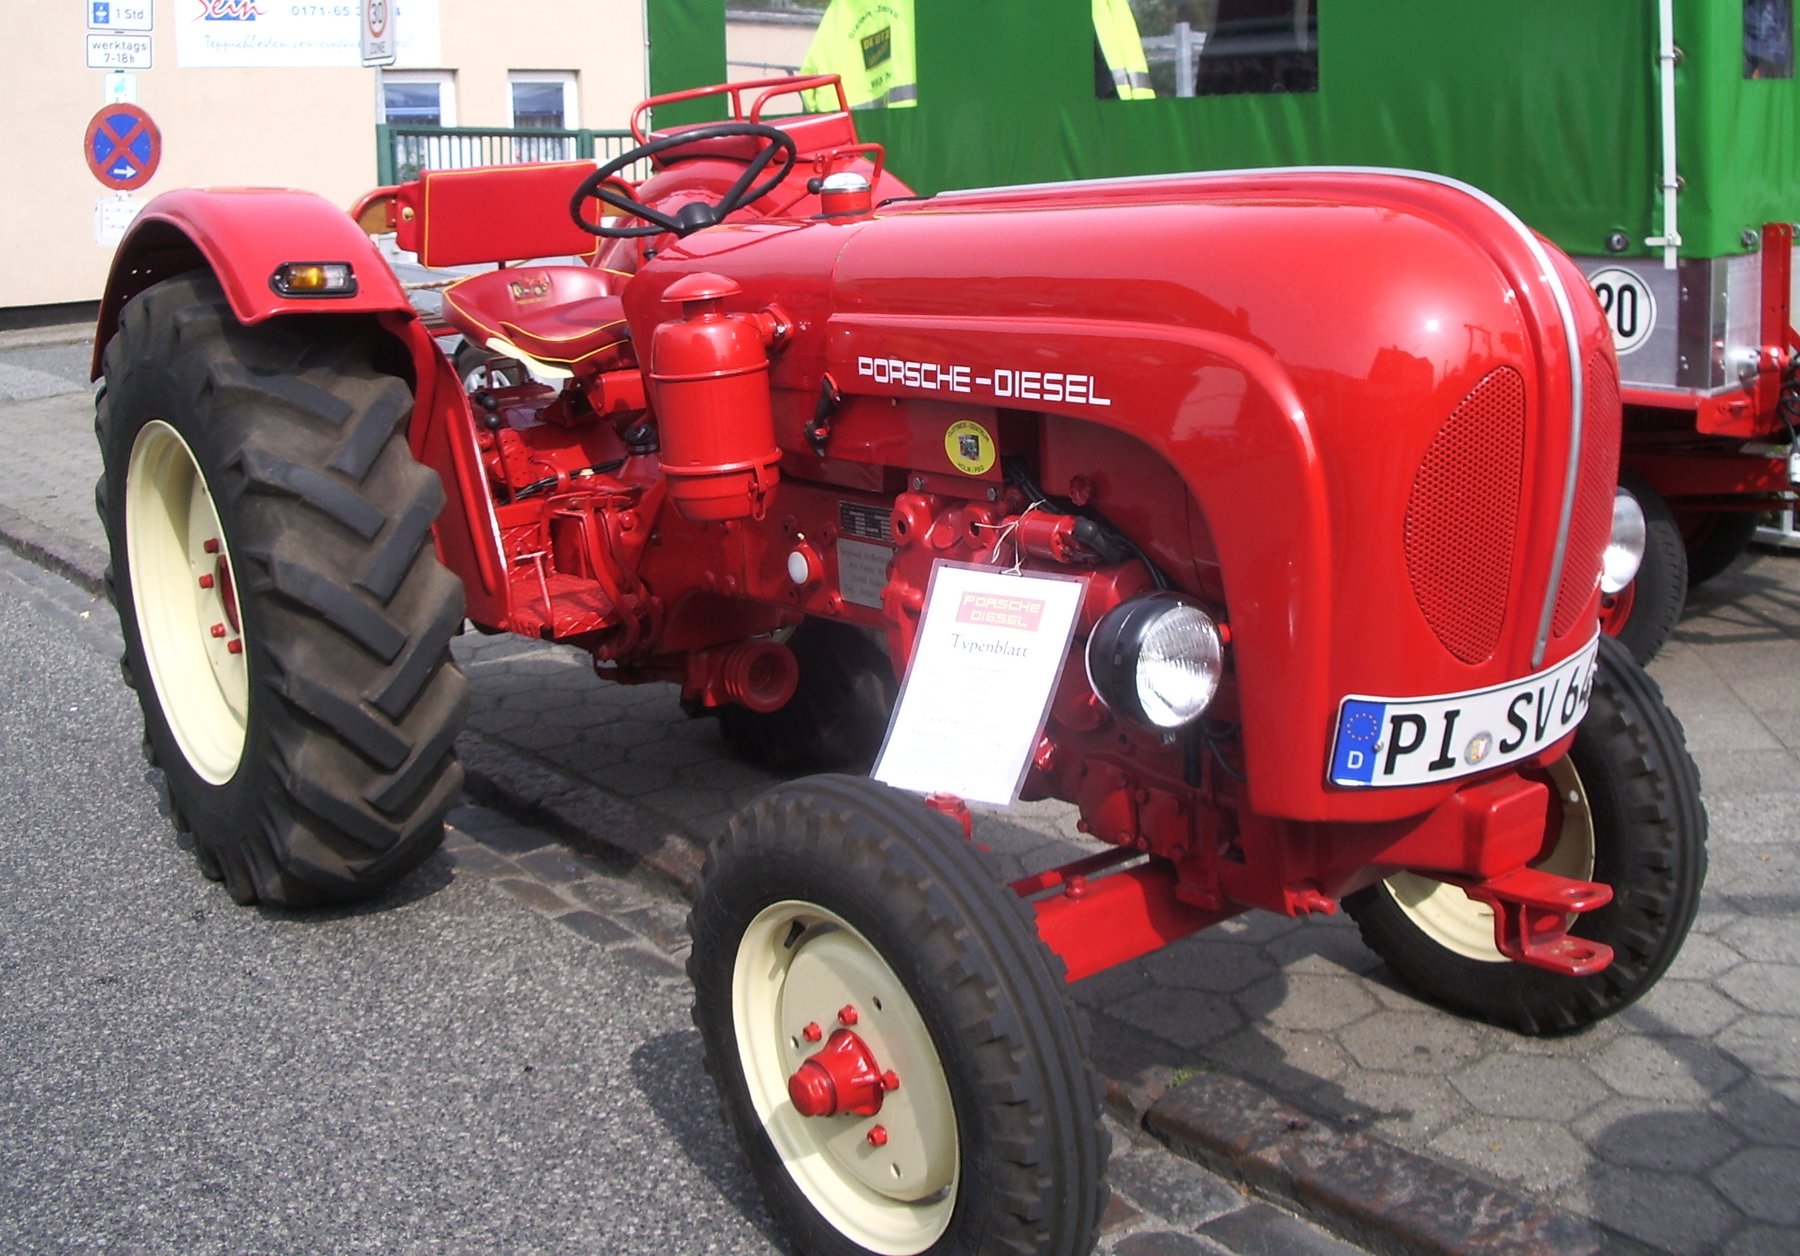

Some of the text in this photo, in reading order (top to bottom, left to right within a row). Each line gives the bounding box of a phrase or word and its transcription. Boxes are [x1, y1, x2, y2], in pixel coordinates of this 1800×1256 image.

[116, 8, 120, 19] 1
[371, 2, 386, 25] 30
[92, 40, 147, 53] werktags
[963, 594, 1042, 614] PORSCHE
[970, 610, 1028, 627] DIESEL
[952, 633, 1029, 658] Typenblatt
[1384, 708, 1461, 775] PI
[1499, 677, 1561, 753] SV
[1347, 751, 1364, 769] D
